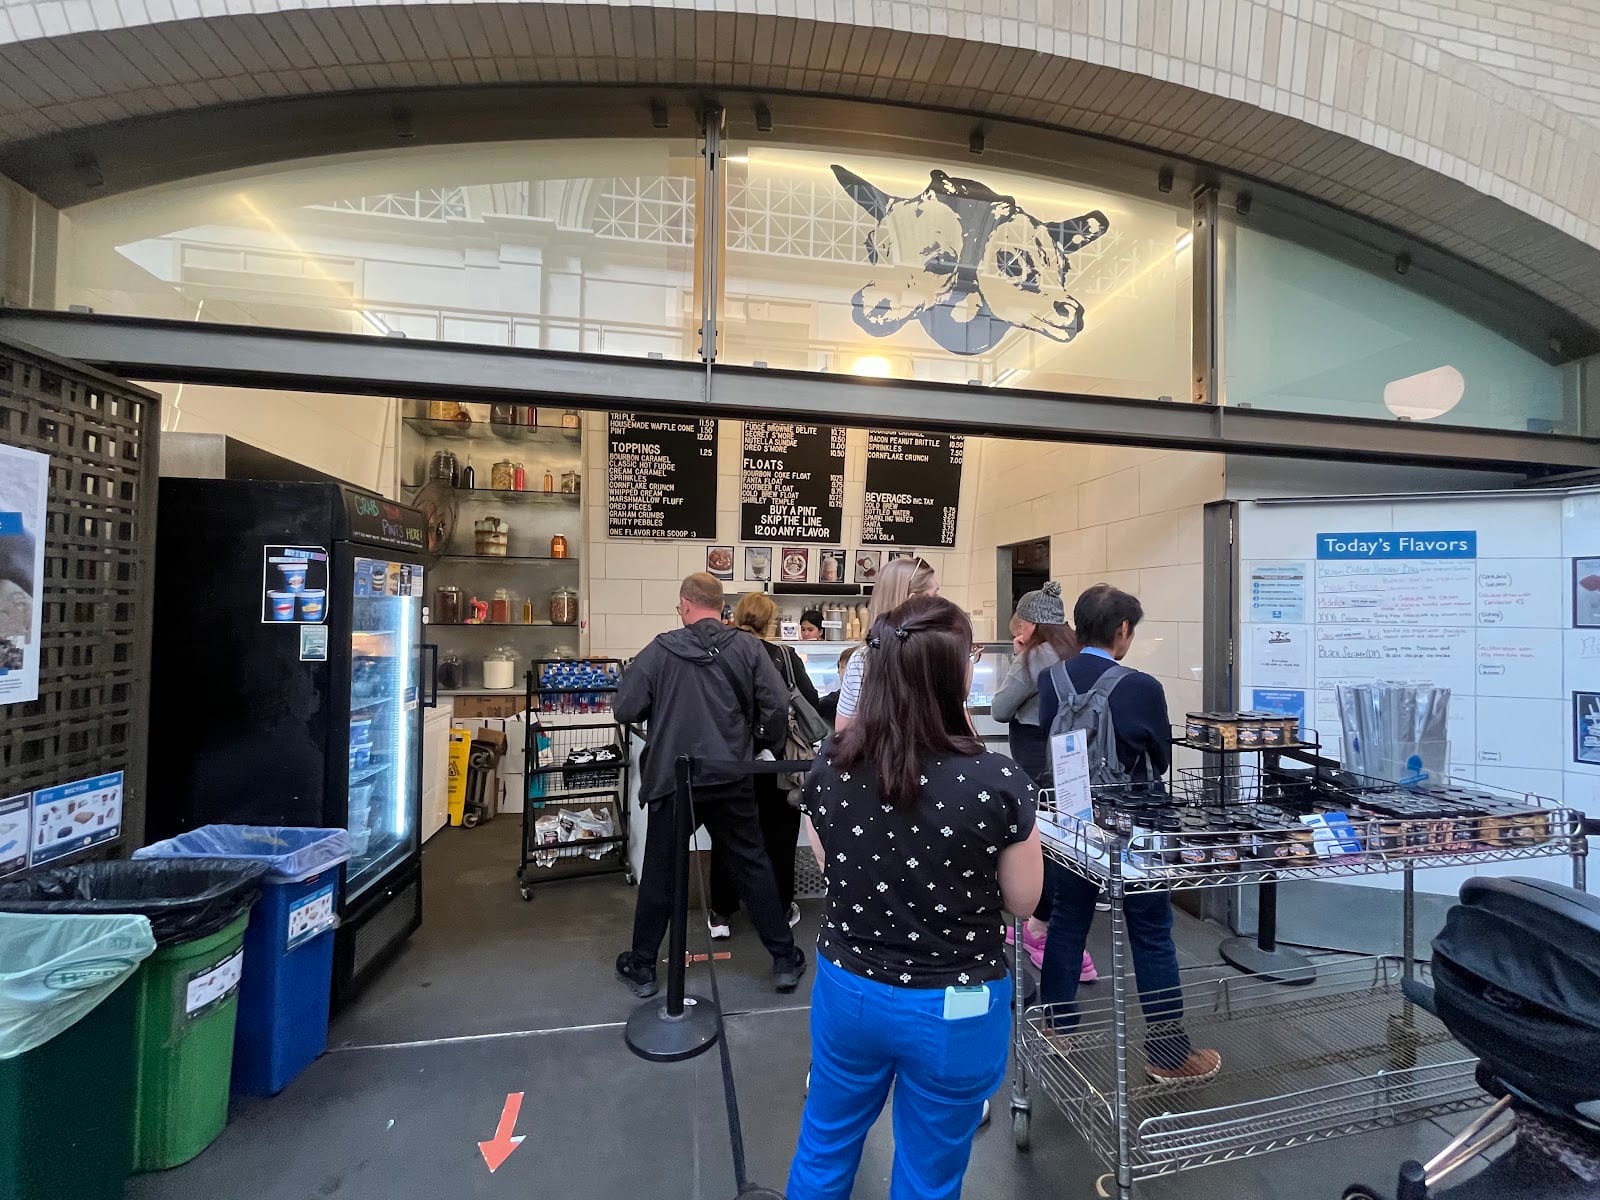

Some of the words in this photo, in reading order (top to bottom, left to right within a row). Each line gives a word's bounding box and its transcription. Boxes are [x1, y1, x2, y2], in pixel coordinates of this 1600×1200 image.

[610, 421, 649, 429] HOUSEMADE
[651, 422, 676, 431] WAFFLE
[678, 424, 695, 432] CONE
[610, 427, 626, 435] PINT
[745, 430, 769, 438] SECRET
[772, 432, 794, 440] S'MORE
[745, 437, 773, 445] NUTELLA
[775, 439, 798, 447] SUNDAE
[870, 435, 888, 443] BACON
[890, 437, 913, 445] PEANUT
[915, 439, 940, 447] BRITTLE
[612, 442, 660, 454] TOPPINGS
[868, 444, 902, 452] SPRINKLES
[610, 453, 639, 461] BOURBON
[868, 452, 904, 460] CORNFLAKE
[905, 454, 928, 462] CRUNCH
[654, 463, 675, 471] FUDGE
[744, 458, 784, 470] FLOATS
[649, 483, 674, 491] CRUNCH
[663, 497, 684, 505] FLUFF
[866, 492, 912, 504] BEVERAGES
[355, 497, 379, 516] GRAB
[770, 506, 788, 514] BUY
[790, 506, 796, 515] A
[798, 507, 817, 516] PINT
[761, 515, 782, 524] SKIP
[783, 516, 800, 525] THE
[802, 517, 822, 526] LINE
[382, 519, 403, 537] PINTS
[778, 527, 795, 536] ANY
[797, 527, 829, 537] FLAVOR
[1324, 538, 1390, 555] Today's
[1400, 538, 1468, 551] Flavors
